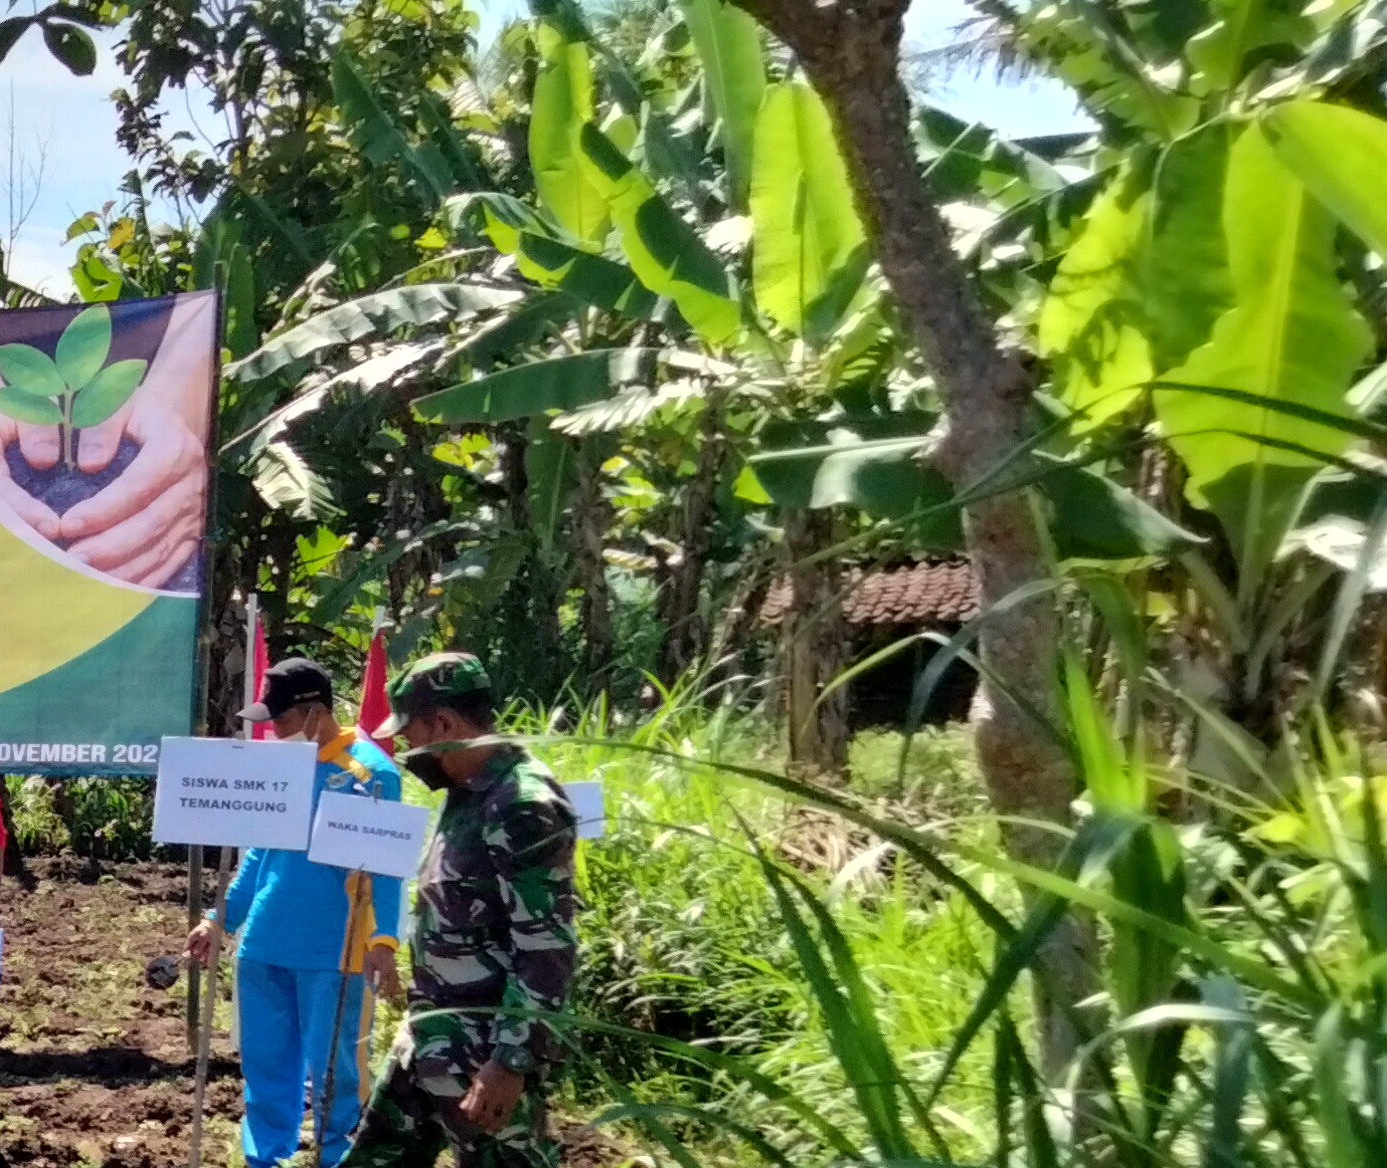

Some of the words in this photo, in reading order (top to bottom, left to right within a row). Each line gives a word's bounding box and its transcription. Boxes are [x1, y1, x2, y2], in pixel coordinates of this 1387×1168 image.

[112, 744, 157, 763] 202
[181, 776, 228, 789] SISWA
[233, 778, 266, 791] SMK
[271, 781, 289, 792] 17
[179, 797, 287, 813] TEMANGGUNG
[327, 820, 359, 832] WAKA
[362, 825, 412, 841] SARPRAS
